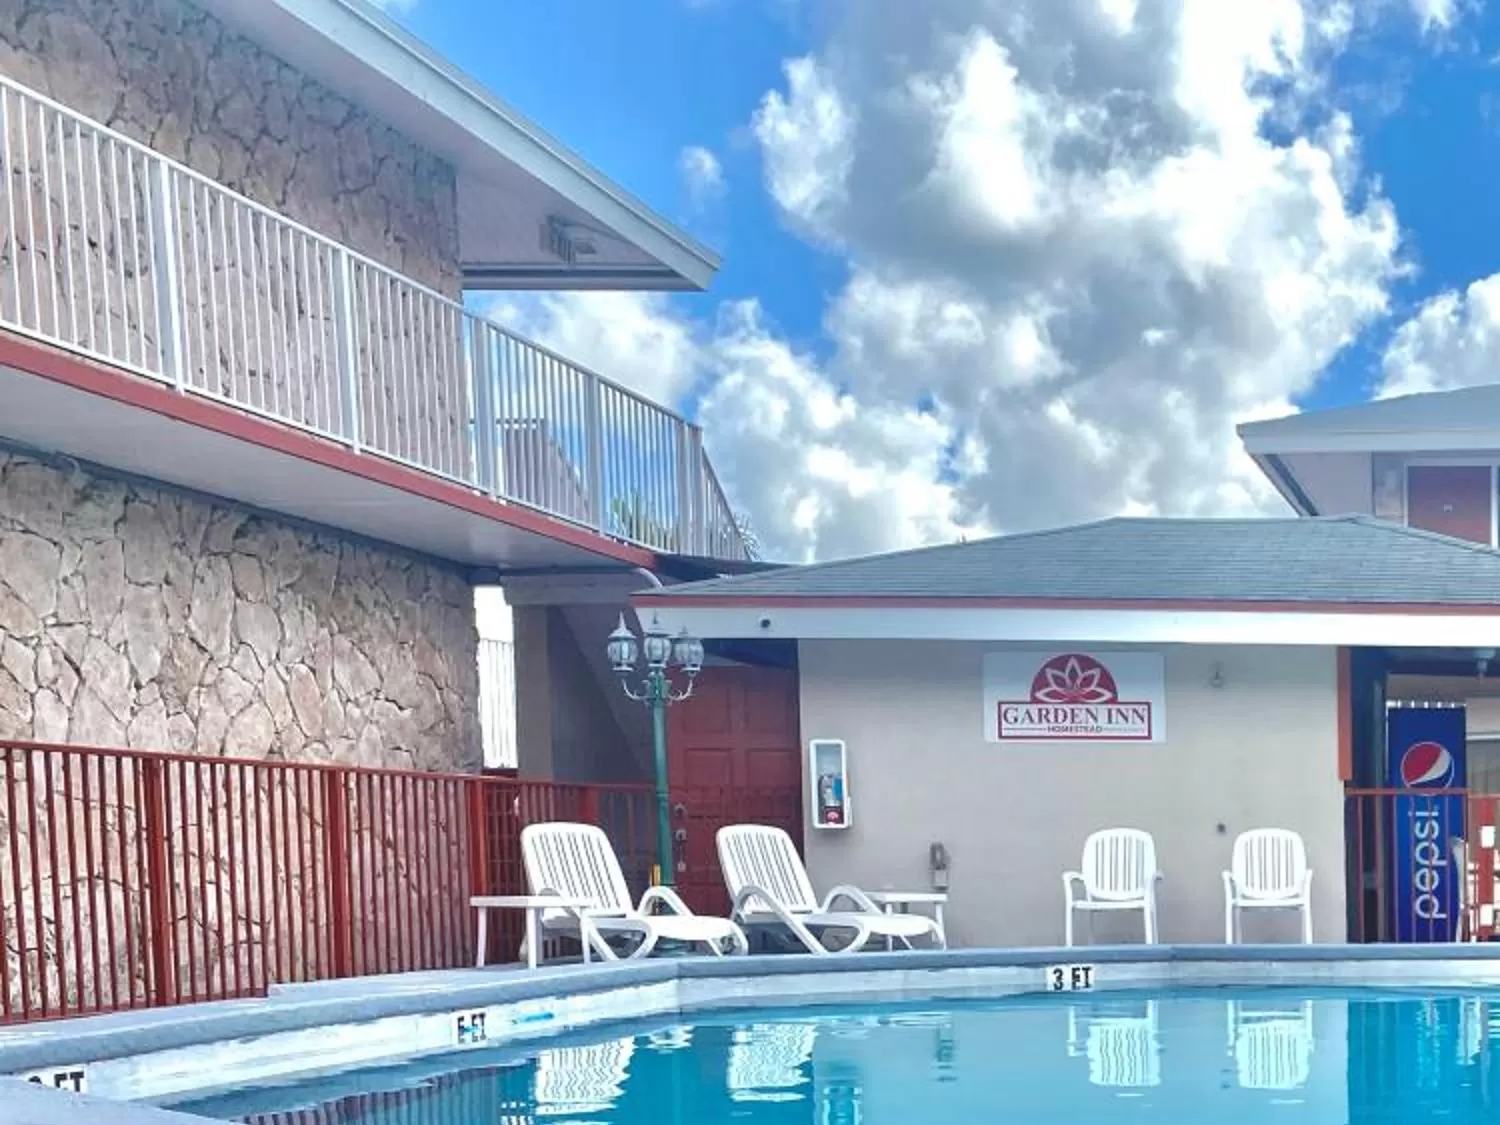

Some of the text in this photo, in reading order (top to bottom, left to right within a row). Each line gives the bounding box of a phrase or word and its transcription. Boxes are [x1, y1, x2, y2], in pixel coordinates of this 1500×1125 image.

[1003, 706, 1145, 725] GARDEN INN
[1047, 725, 1102, 733] HOMESTEAD
[1408, 810, 1447, 919] pepsi
[1053, 966, 1092, 990] 3 FT
